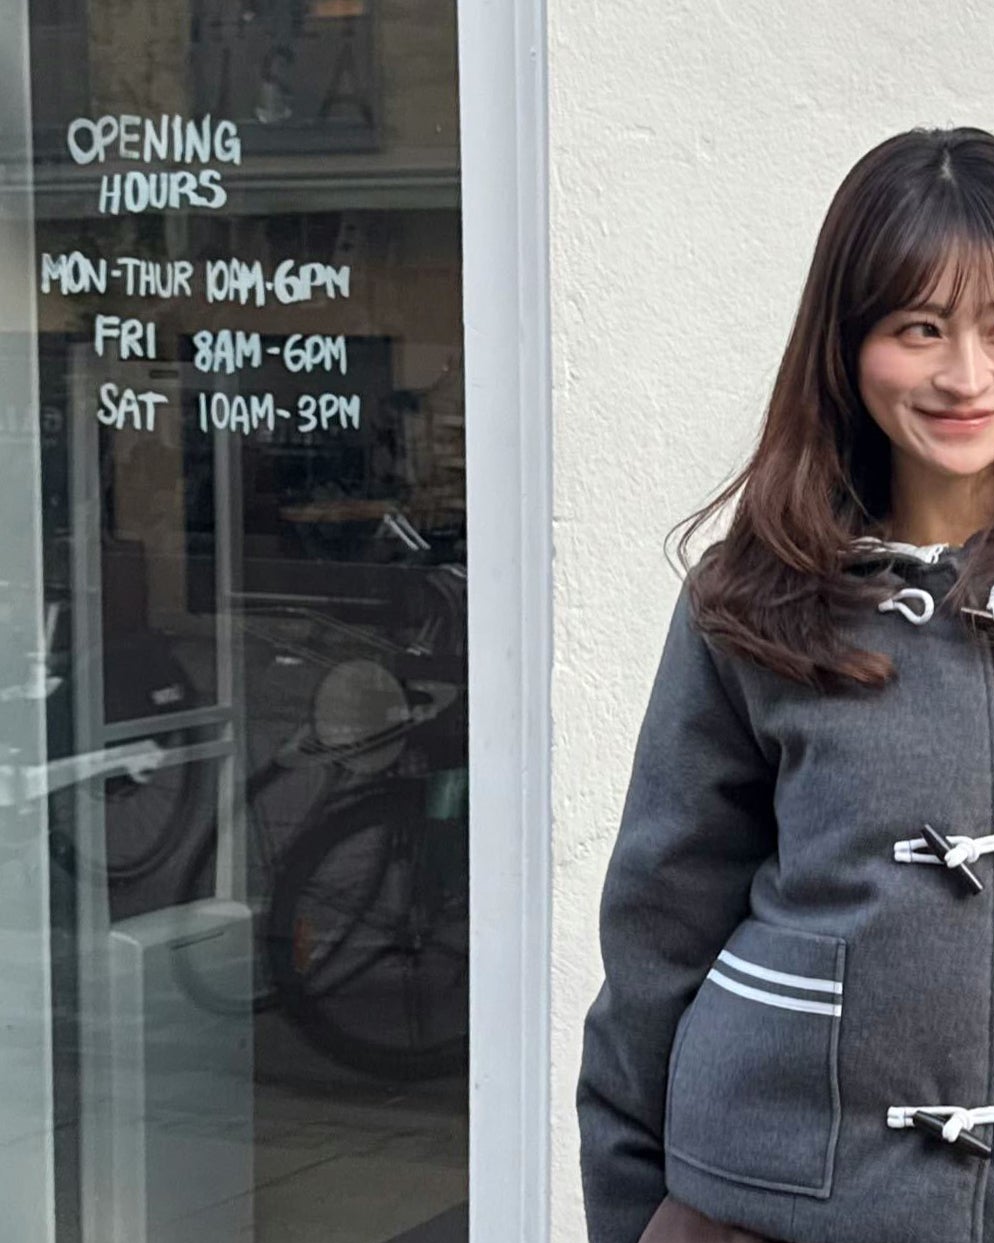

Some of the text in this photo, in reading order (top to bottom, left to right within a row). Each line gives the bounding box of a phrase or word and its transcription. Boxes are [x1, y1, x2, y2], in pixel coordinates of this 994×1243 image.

[67, 113, 241, 165] OPENING
[99, 169, 228, 215] HOURS
[95, 314, 156, 360] FRI
[97, 383, 168, 431] SAT
